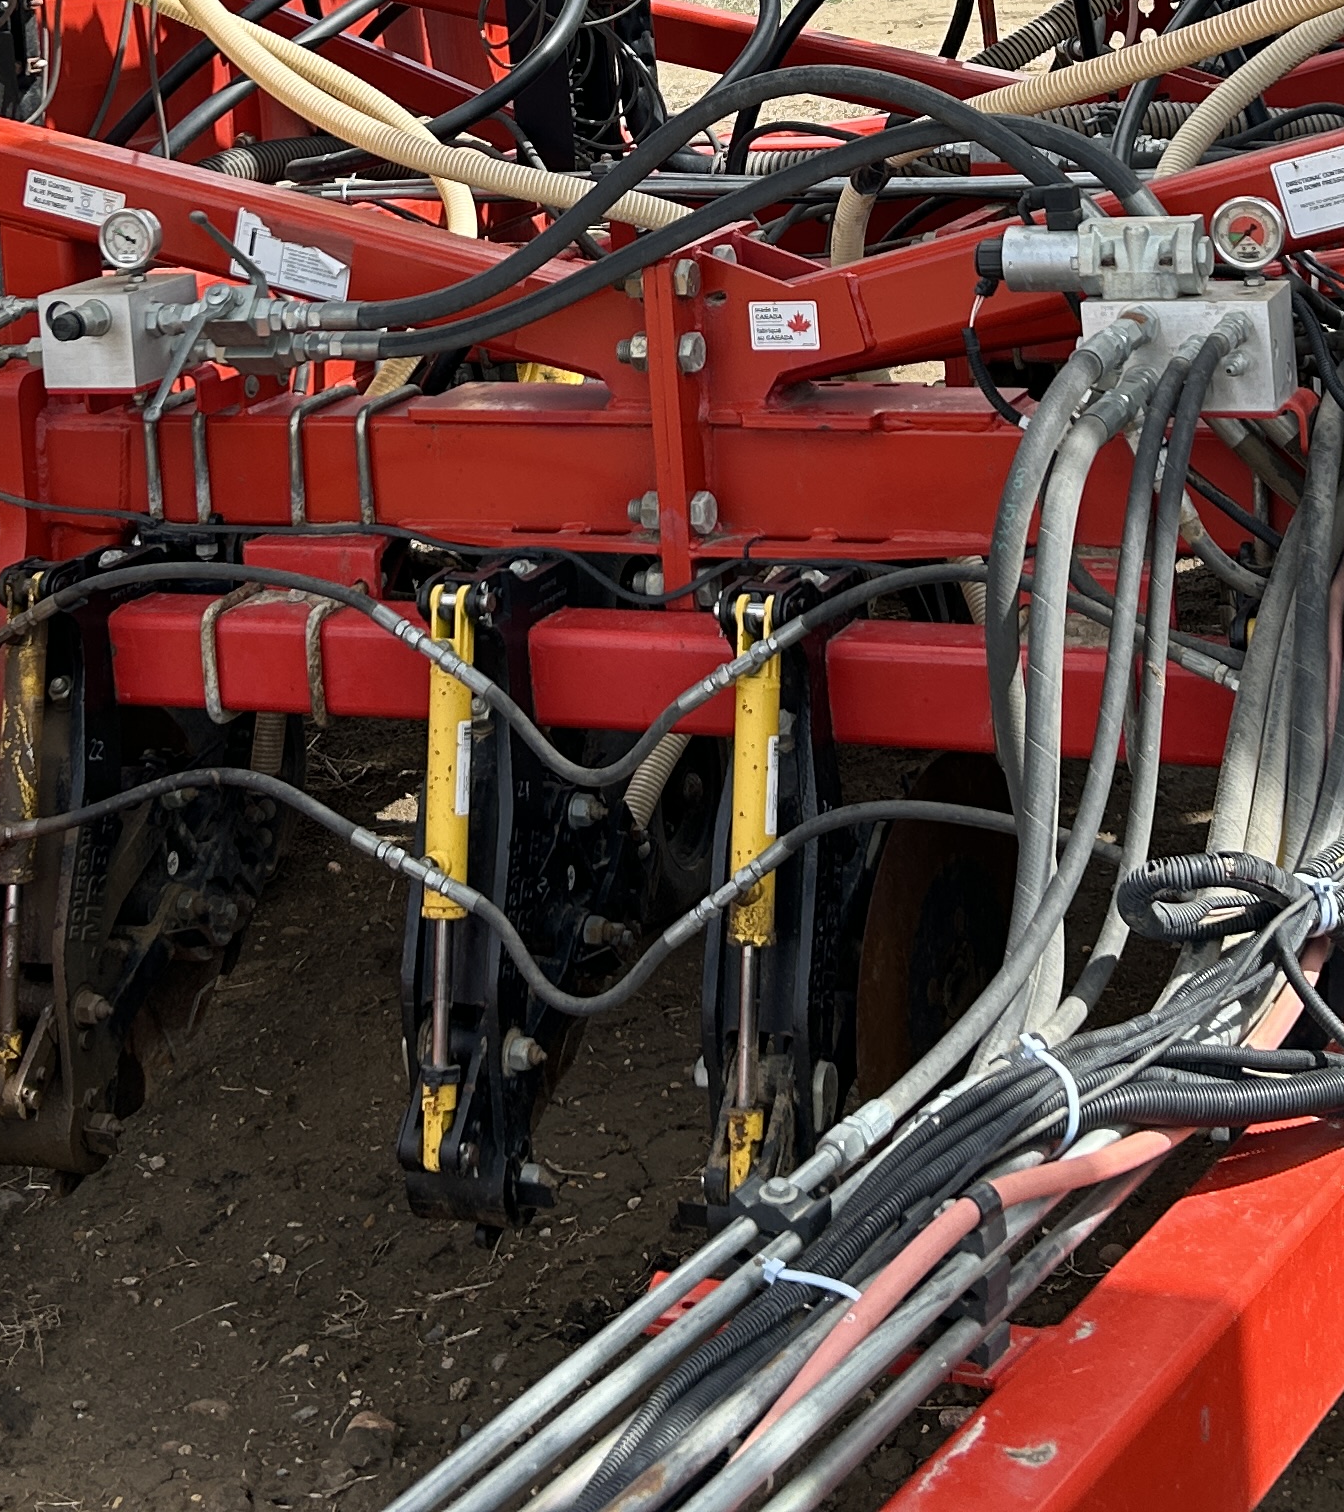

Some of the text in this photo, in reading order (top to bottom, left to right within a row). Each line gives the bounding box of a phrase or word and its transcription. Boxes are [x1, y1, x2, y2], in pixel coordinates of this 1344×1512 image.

[1285, 172, 1322, 189] DIRECTIONAL
[1288, 185, 1303, 195] WING
[1304, 181, 1321, 191] DOWN
[88, 737, 105, 761] 22
[517, 780, 530, 802] 21
